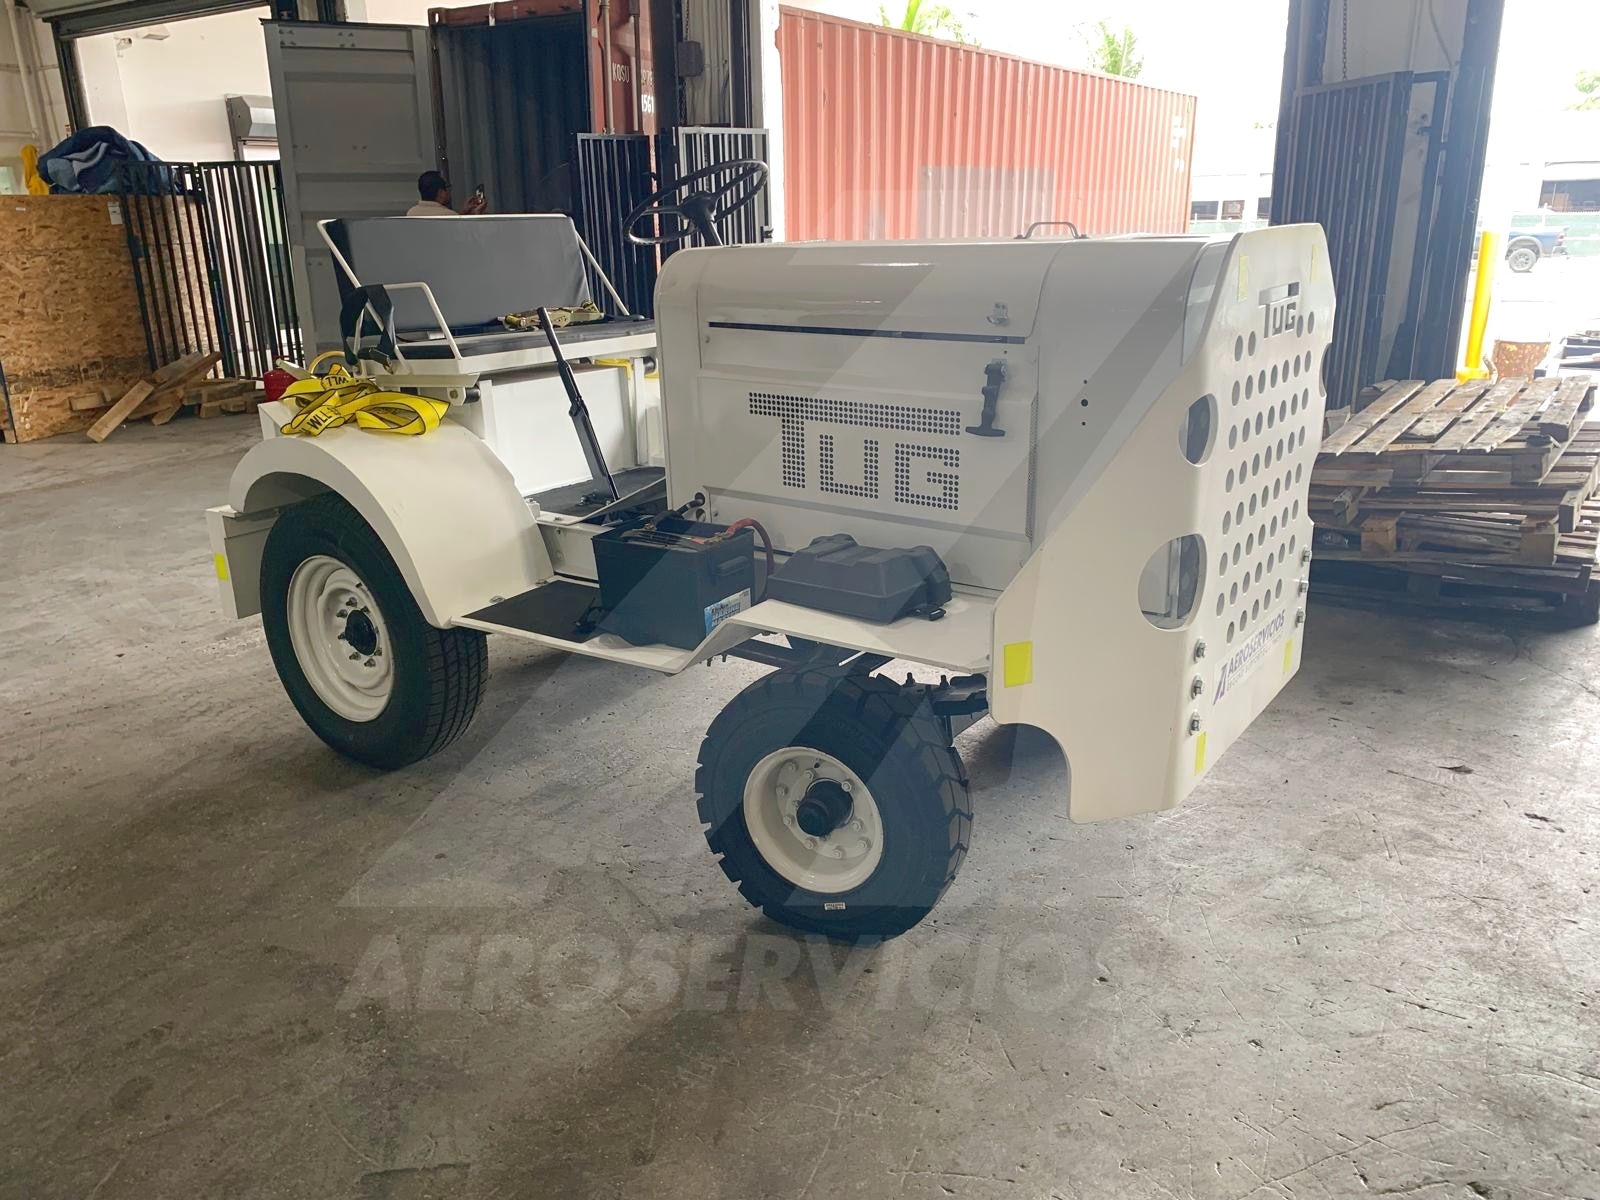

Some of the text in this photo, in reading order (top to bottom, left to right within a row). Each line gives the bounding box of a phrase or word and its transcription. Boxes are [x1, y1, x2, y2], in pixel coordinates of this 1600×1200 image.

[612, 62, 630, 83] KOSU
[1259, 281, 1300, 339] TUG
[306, 410, 333, 430] WLL
[749, 392, 961, 511] TUG
[1228, 608, 1286, 677] AEROSERVICIOS
